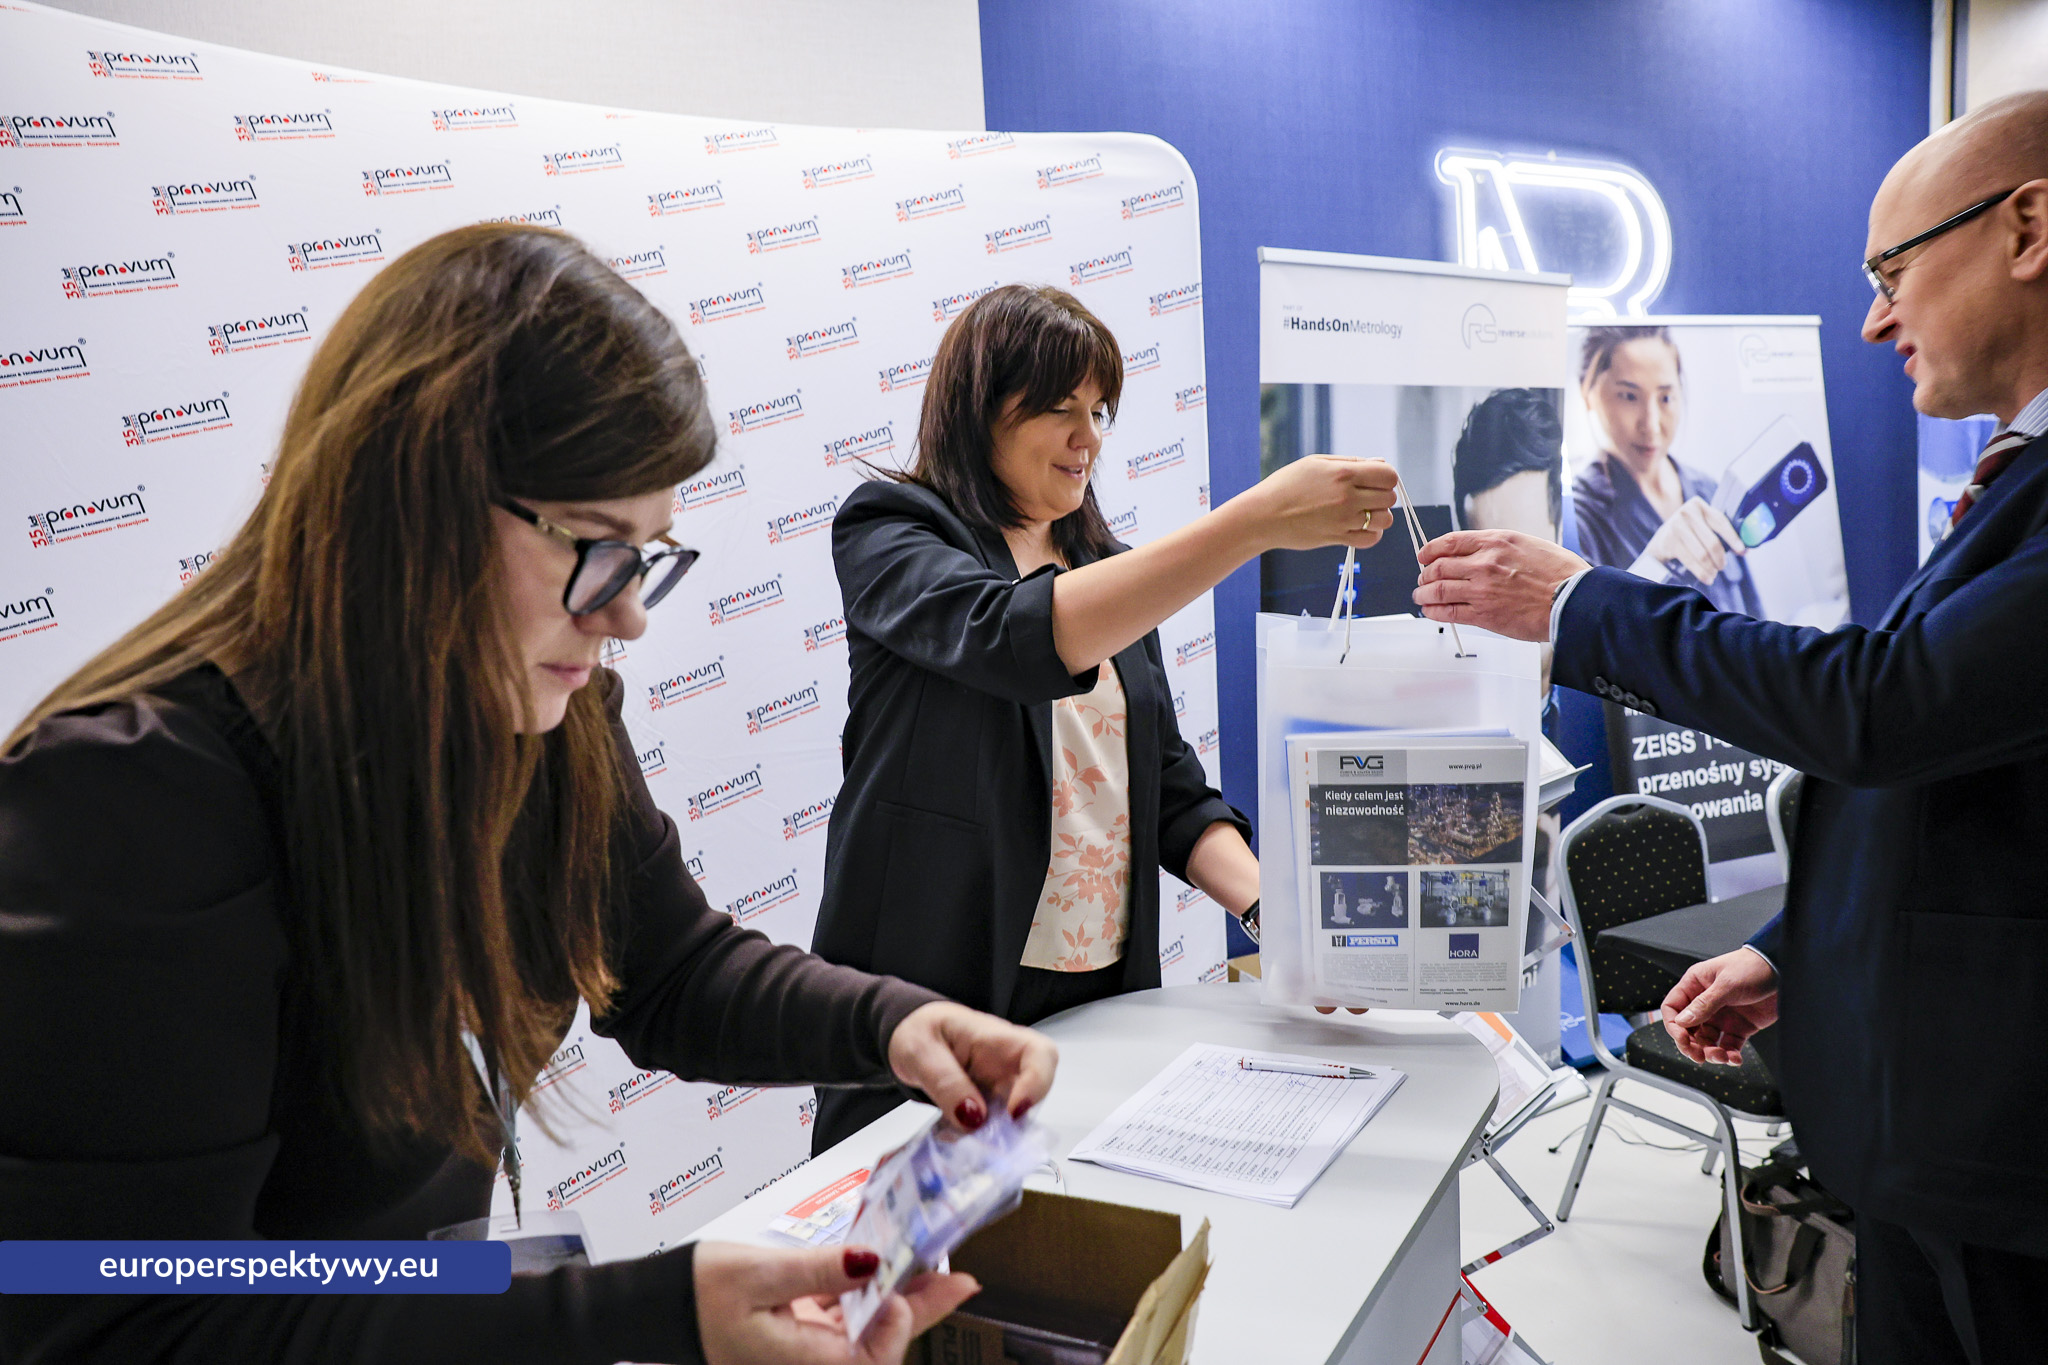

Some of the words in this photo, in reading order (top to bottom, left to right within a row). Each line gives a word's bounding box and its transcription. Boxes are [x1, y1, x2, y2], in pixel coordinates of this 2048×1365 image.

[103, 53, 199, 73] pronovum
[12, 116, 116, 138] pronovum
[248, 114, 331, 133] pronovum
[444, 108, 515, 124] pronovum
[375, 165, 451, 188] pronovum
[167, 181, 256, 206] pronovum
[302, 235, 381, 262] pronovum
[79, 259, 175, 288] pronovum
[223, 313, 308, 344] pronovum
[1283, 316, 1403, 339] #HandsOnMetrology
[138, 399, 229, 435] pronovum
[46, 493, 145, 534] pronovum
[720, 580, 781, 614] pronovum
[814, 617, 845, 641] prono
[660, 662, 724, 699] pronovum
[757, 687, 817, 724] pronovum
[1632, 730, 1697, 761] ZEISS
[699, 771, 760, 809] pronovum
[1638, 760, 1745, 796] przenośny
[1325, 790, 1352, 802] Kiedy
[1354, 791, 1383, 800] celem
[1384, 790, 1404, 802] jest
[1325, 804, 1404, 816] niezawodność
[737, 875, 796, 915] pronovum
[1449, 949, 1478, 958] HORA
[558, 1150, 625, 1200] pronovum
[660, 1154, 722, 1202] pronovum
